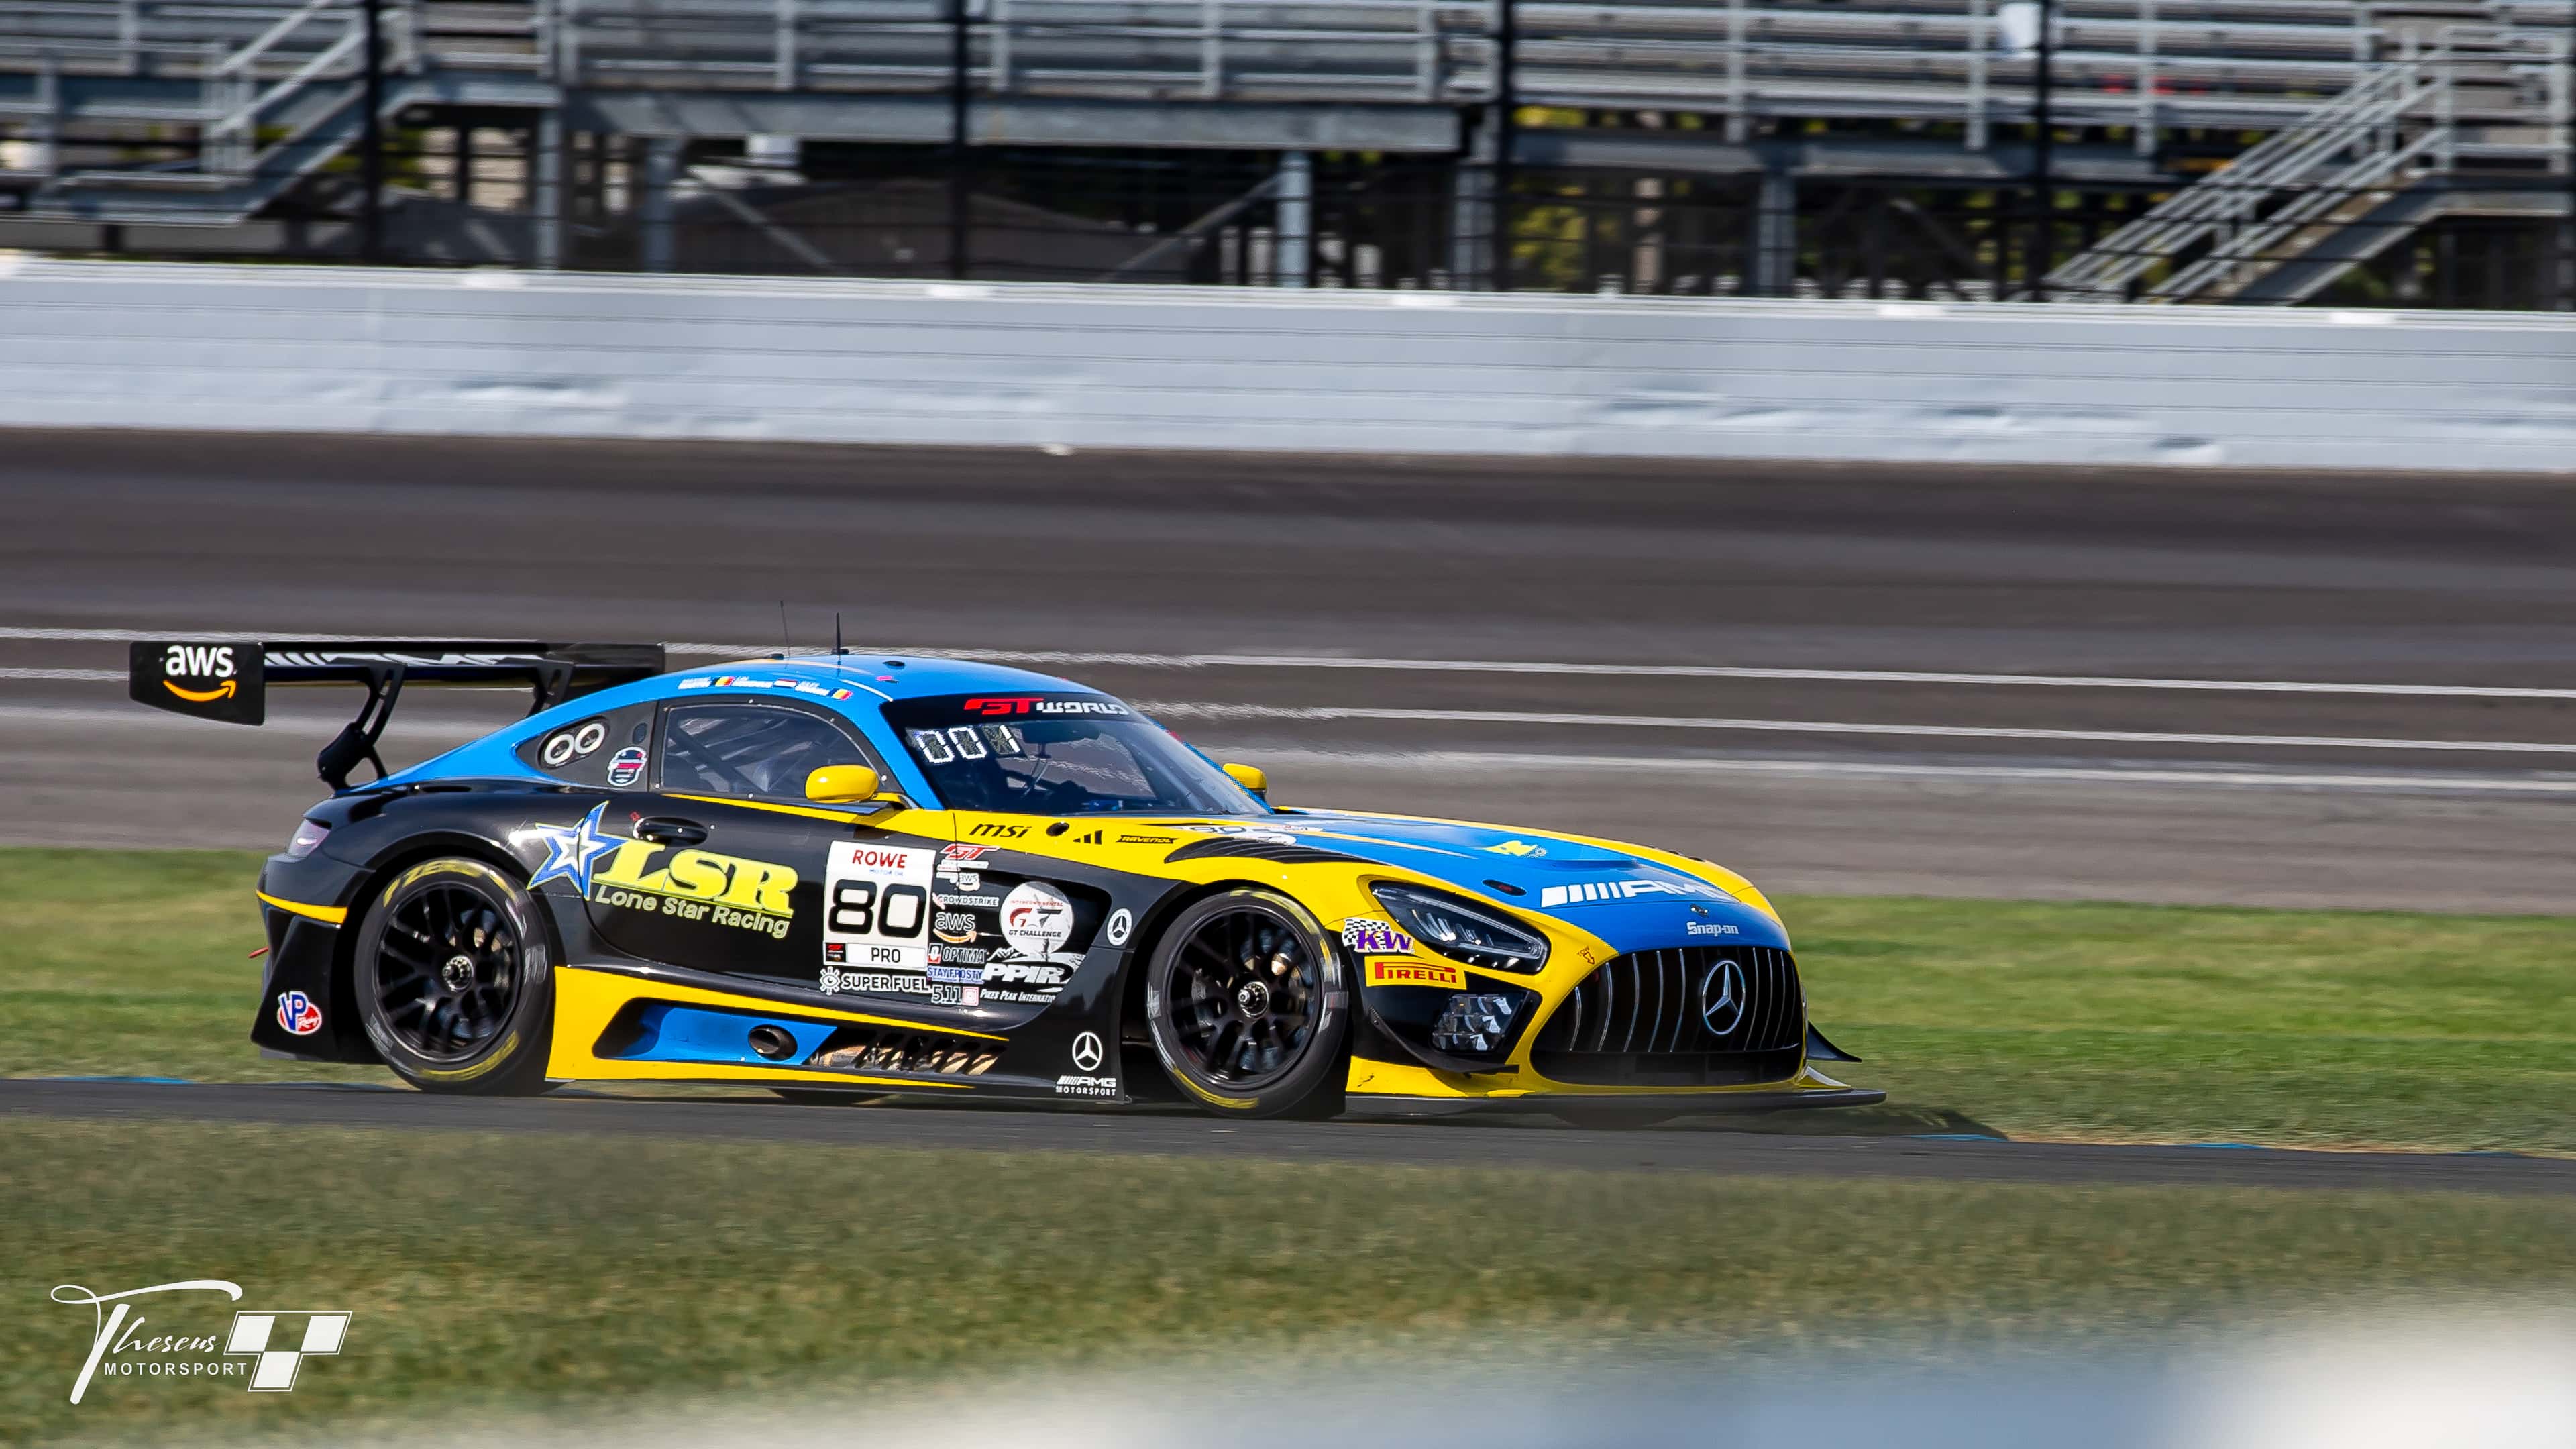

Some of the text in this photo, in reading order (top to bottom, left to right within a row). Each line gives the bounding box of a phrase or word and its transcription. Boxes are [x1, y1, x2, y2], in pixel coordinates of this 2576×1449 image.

[165, 645, 235, 678] aws
[963, 698, 1130, 716] GT WORLD
[1121, 836, 1173, 844] RAVENOL
[851, 849, 908, 869] ROWE
[940, 843, 1000, 860] GT
[594, 837, 798, 916] LSR
[828, 879, 927, 938] 80
[938, 894, 998, 906] CROWDSTRIKE
[594, 884, 791, 940] Lone Star Racing
[934, 912, 976, 932] aws
[1686, 921, 1739, 937] Snap-on
[1019, 930, 1062, 938] CHALLENGE
[1356, 928, 1413, 951] KW
[871, 947, 901, 963] PRO
[943, 946, 985, 963] OPTIMA
[982, 962, 1065, 984] PPIR
[1375, 961, 1457, 983] PIRELLI
[932, 985, 961, 1004] 5.11
[278, 991, 309, 1032] VP
[1055, 1085, 1116, 1096] MOTORSPORT
[1077, 1076, 1116, 1087] AMG
